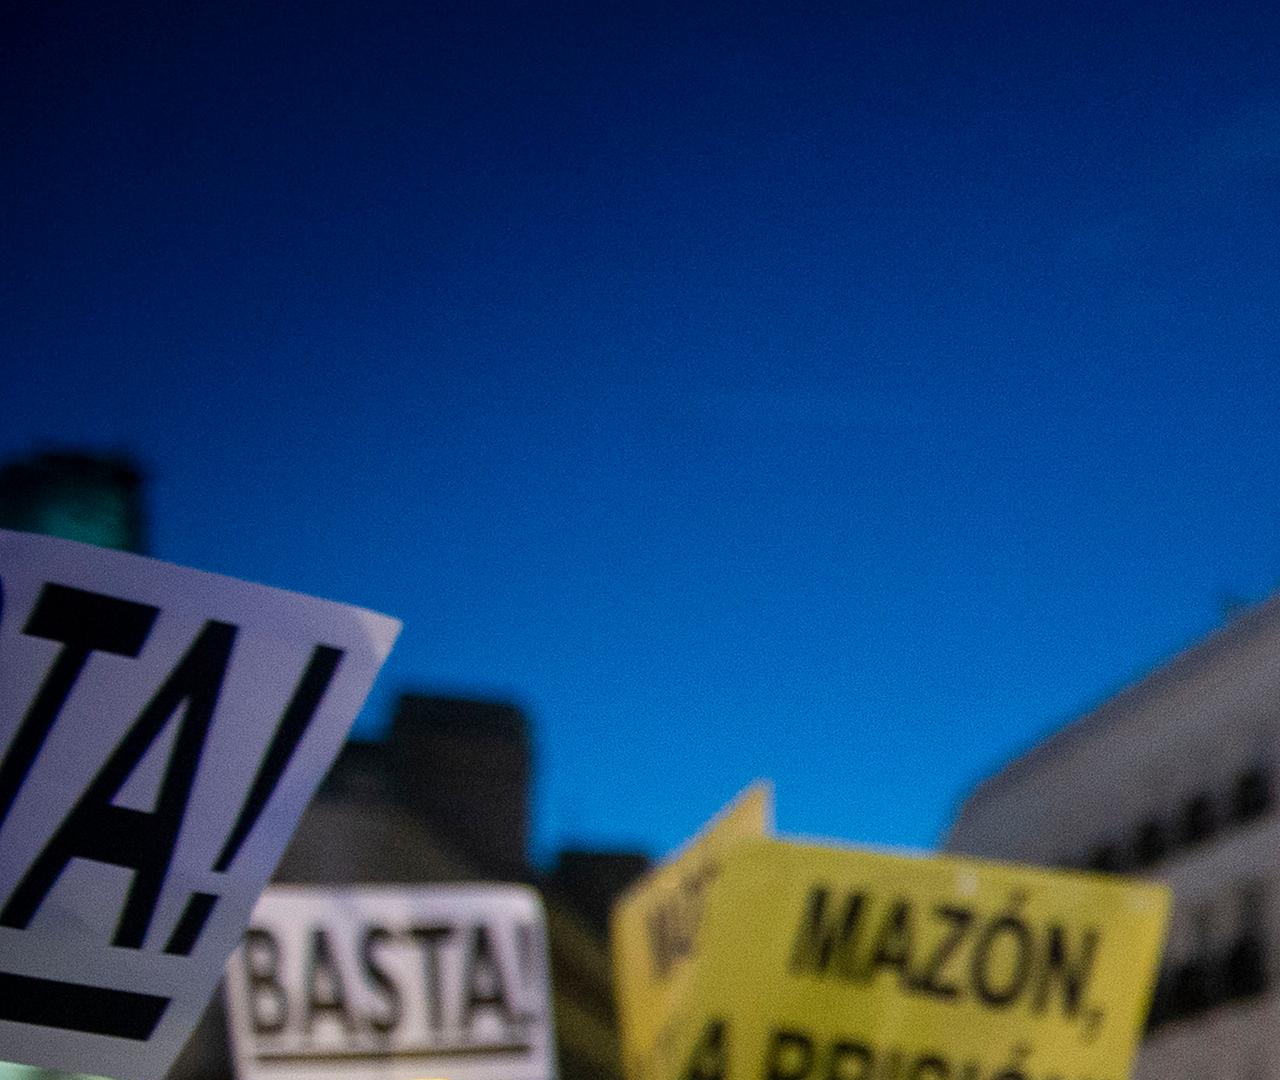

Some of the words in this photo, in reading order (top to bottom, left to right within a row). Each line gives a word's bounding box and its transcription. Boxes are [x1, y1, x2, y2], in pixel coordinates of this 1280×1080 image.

[0, 581, 344, 957] TA!
[241, 920, 537, 1037] BASTA!
[788, 882, 1106, 1042] MAZÓN,
